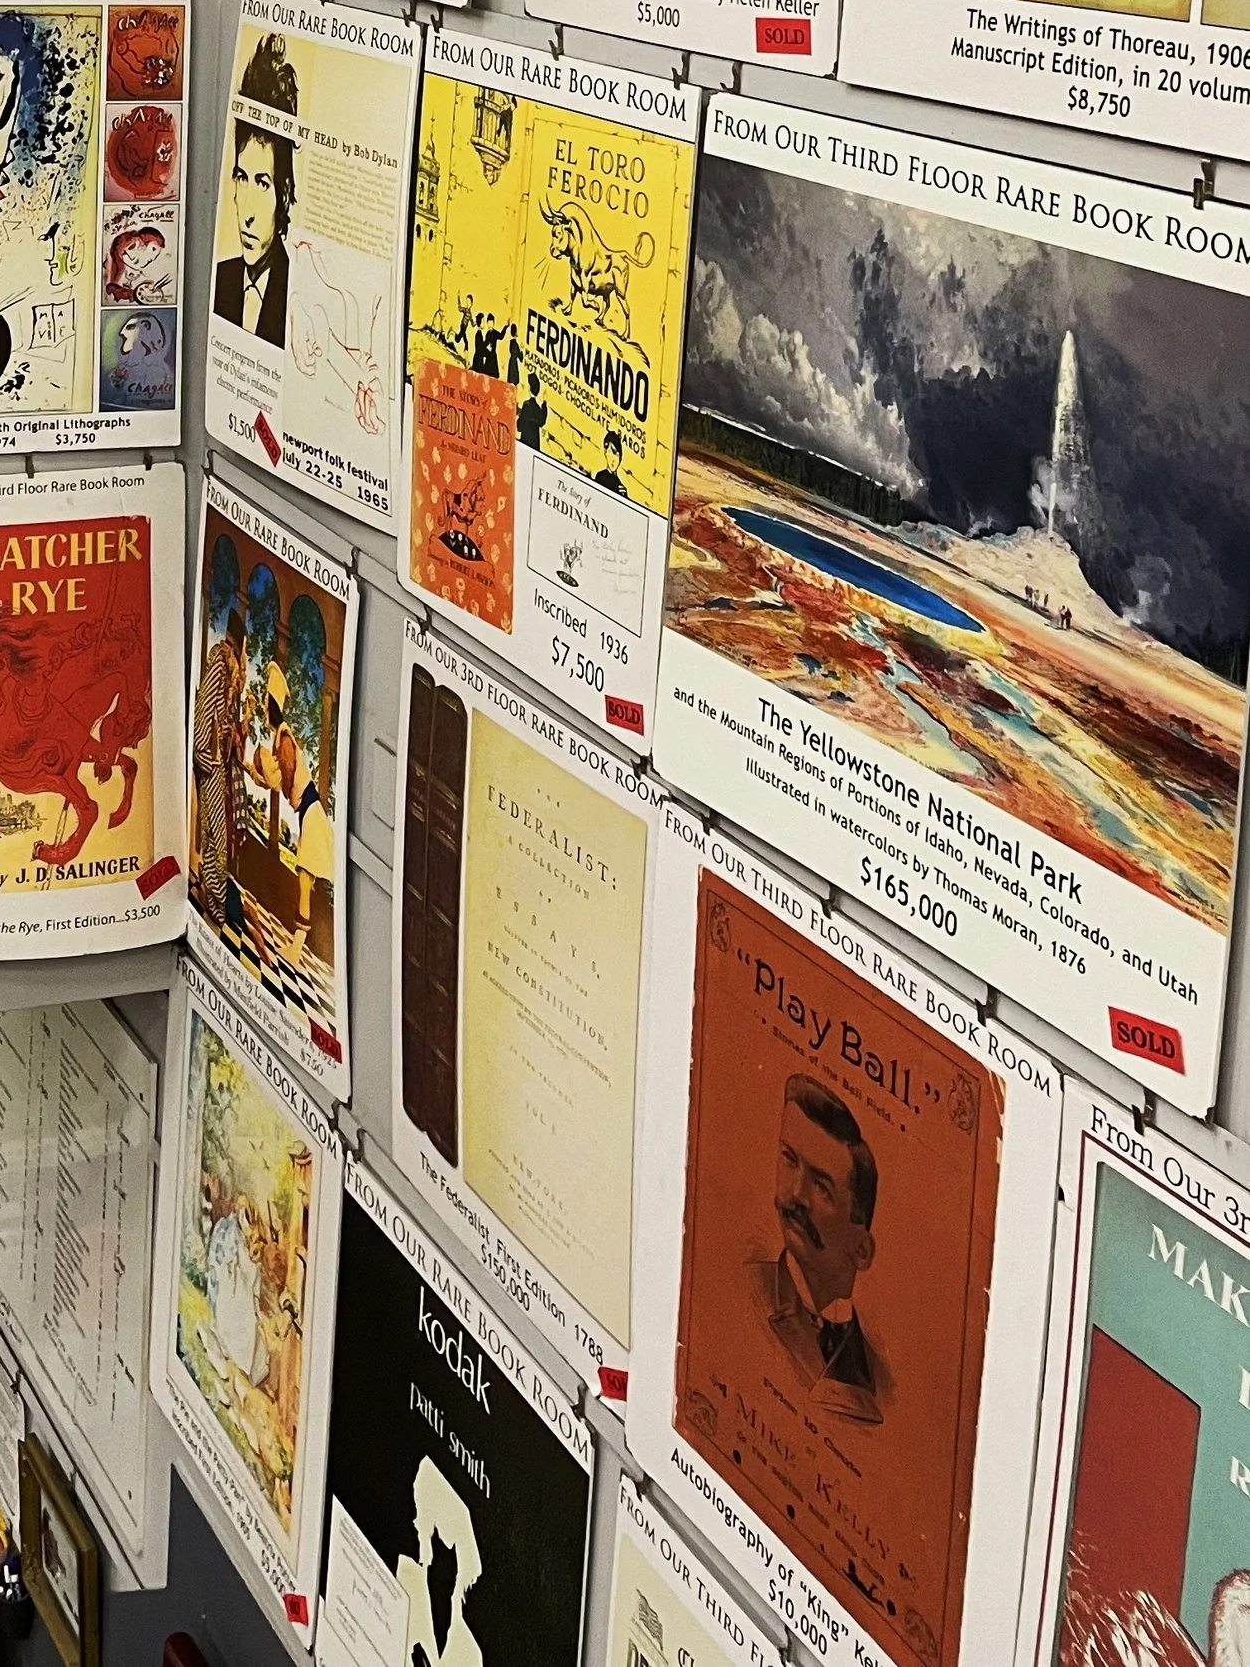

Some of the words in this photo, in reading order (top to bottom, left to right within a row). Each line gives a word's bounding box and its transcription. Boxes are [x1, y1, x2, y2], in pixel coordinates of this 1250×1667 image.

[638, 1, 679, 27] $5,000
[967, 9, 997, 31] The
[1005, 14, 1076, 46] Writings
[1084, 26, 1103, 46] of
[1110, 29, 1195, 65] Thoreau,
[1068, 86, 1130, 117] $8,750
[556, 139, 577, 165] EL
[588, 147, 645, 183] TORO
[547, 167, 648, 218] FEROCIO
[526, 309, 649, 423] FERDINANDO
[14, 420, 59, 433] Original
[64, 417, 130, 430] Lithographs
[283, 432, 323, 460] newport
[325, 451, 345, 471] folk
[348, 462, 387, 491] festival
[283, 448, 301, 470] July
[306, 461, 342, 488] 22-25
[358, 486, 388, 510] 1965
[12, 578, 87, 615] RYE
[535, 588, 587, 638] Inscribed
[601, 632, 628, 664] 1936
[552, 632, 604, 692] $7,500
[759, 698, 792, 736] The
[800, 719, 920, 809] Yellowstone
[927, 793, 1021, 869] National
[1029, 851, 1081, 904] Park
[16, 869, 29, 883] J.
[35, 864, 51, 883] D.
[56, 856, 140, 880] SALINGER
[861, 856, 958, 938] $165,000
[420, 1152, 437, 1183] The
[440, 1175, 490, 1244] Federalist
[497, 1239, 521, 1278] First
[525, 1269, 566, 1328] Edition
[575, 1325, 604, 1366] 1788
[481, 1243, 529, 1311] $150,000
[418, 1286, 491, 1415] kodak
